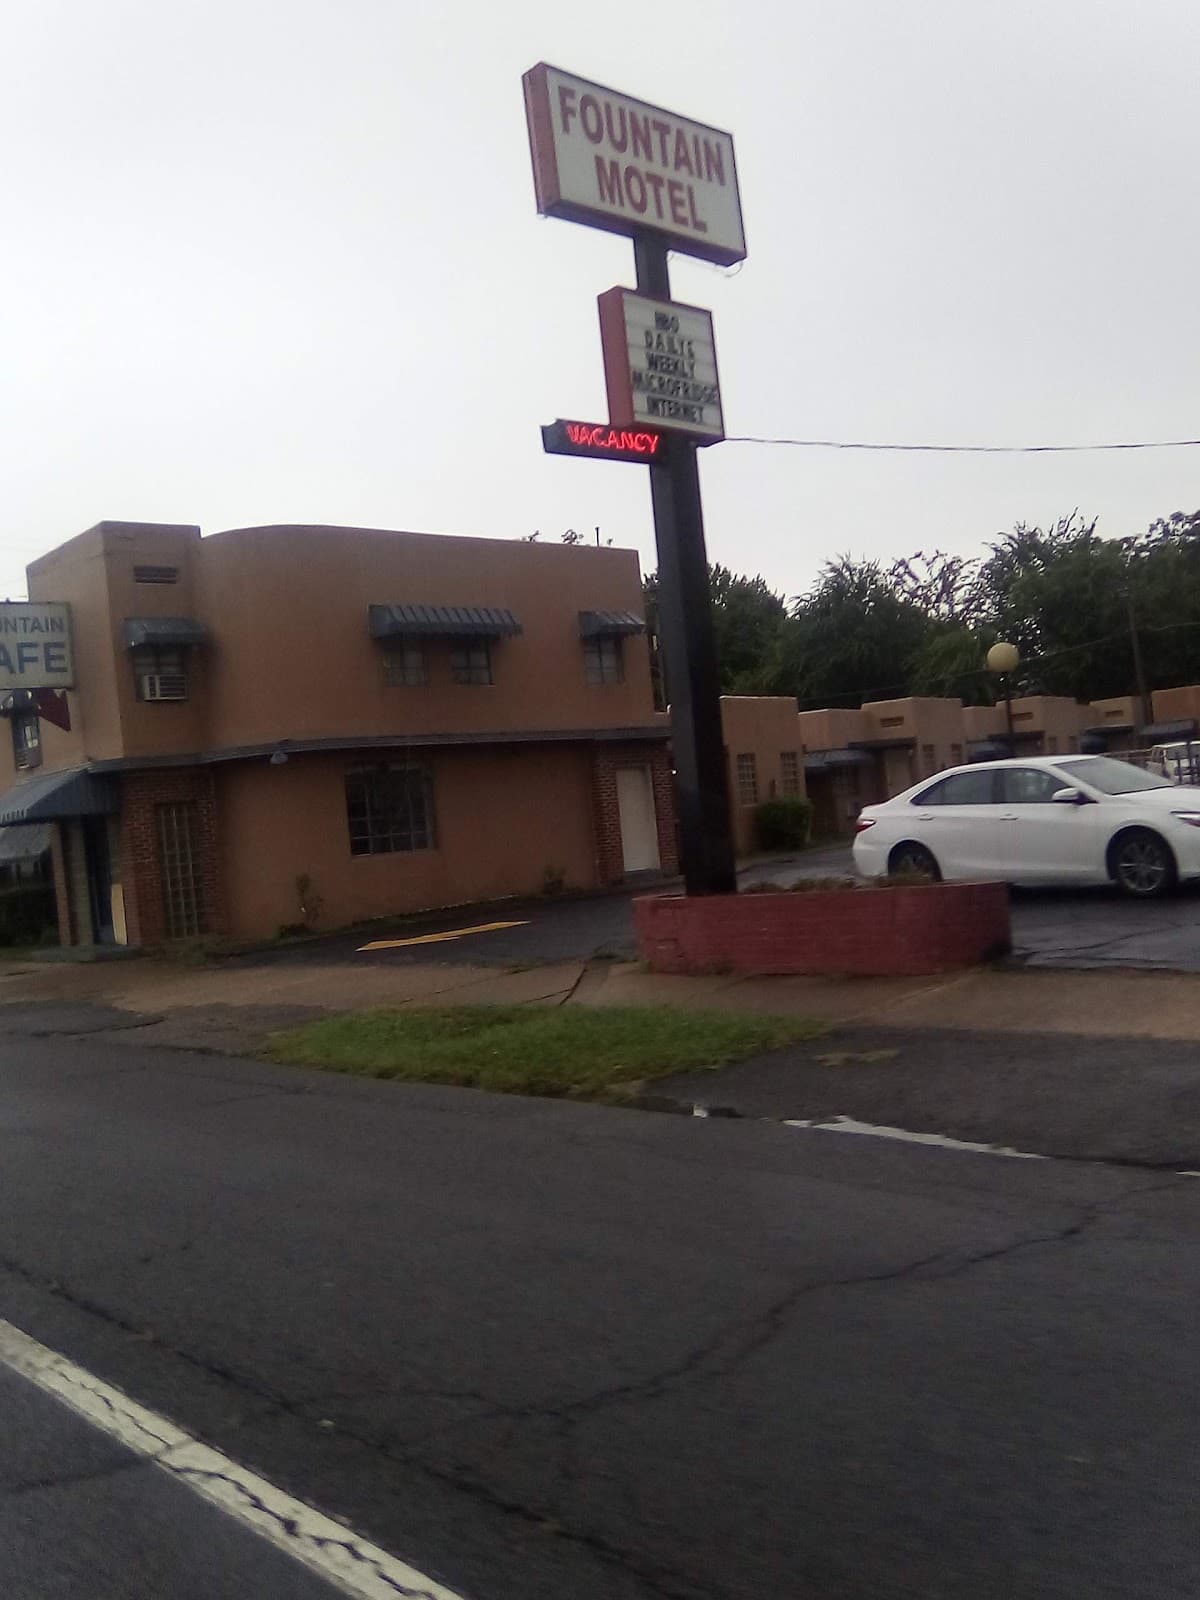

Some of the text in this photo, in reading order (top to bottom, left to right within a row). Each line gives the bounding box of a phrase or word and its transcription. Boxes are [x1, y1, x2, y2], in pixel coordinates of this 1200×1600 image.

[558, 85, 727, 187] FOUNTAIN
[594, 154, 708, 234] MOTEL
[646, 350, 695, 380] WEEKLY
[645, 394, 704, 424] INTERNET
[567, 424, 659, 453] VACANCY
